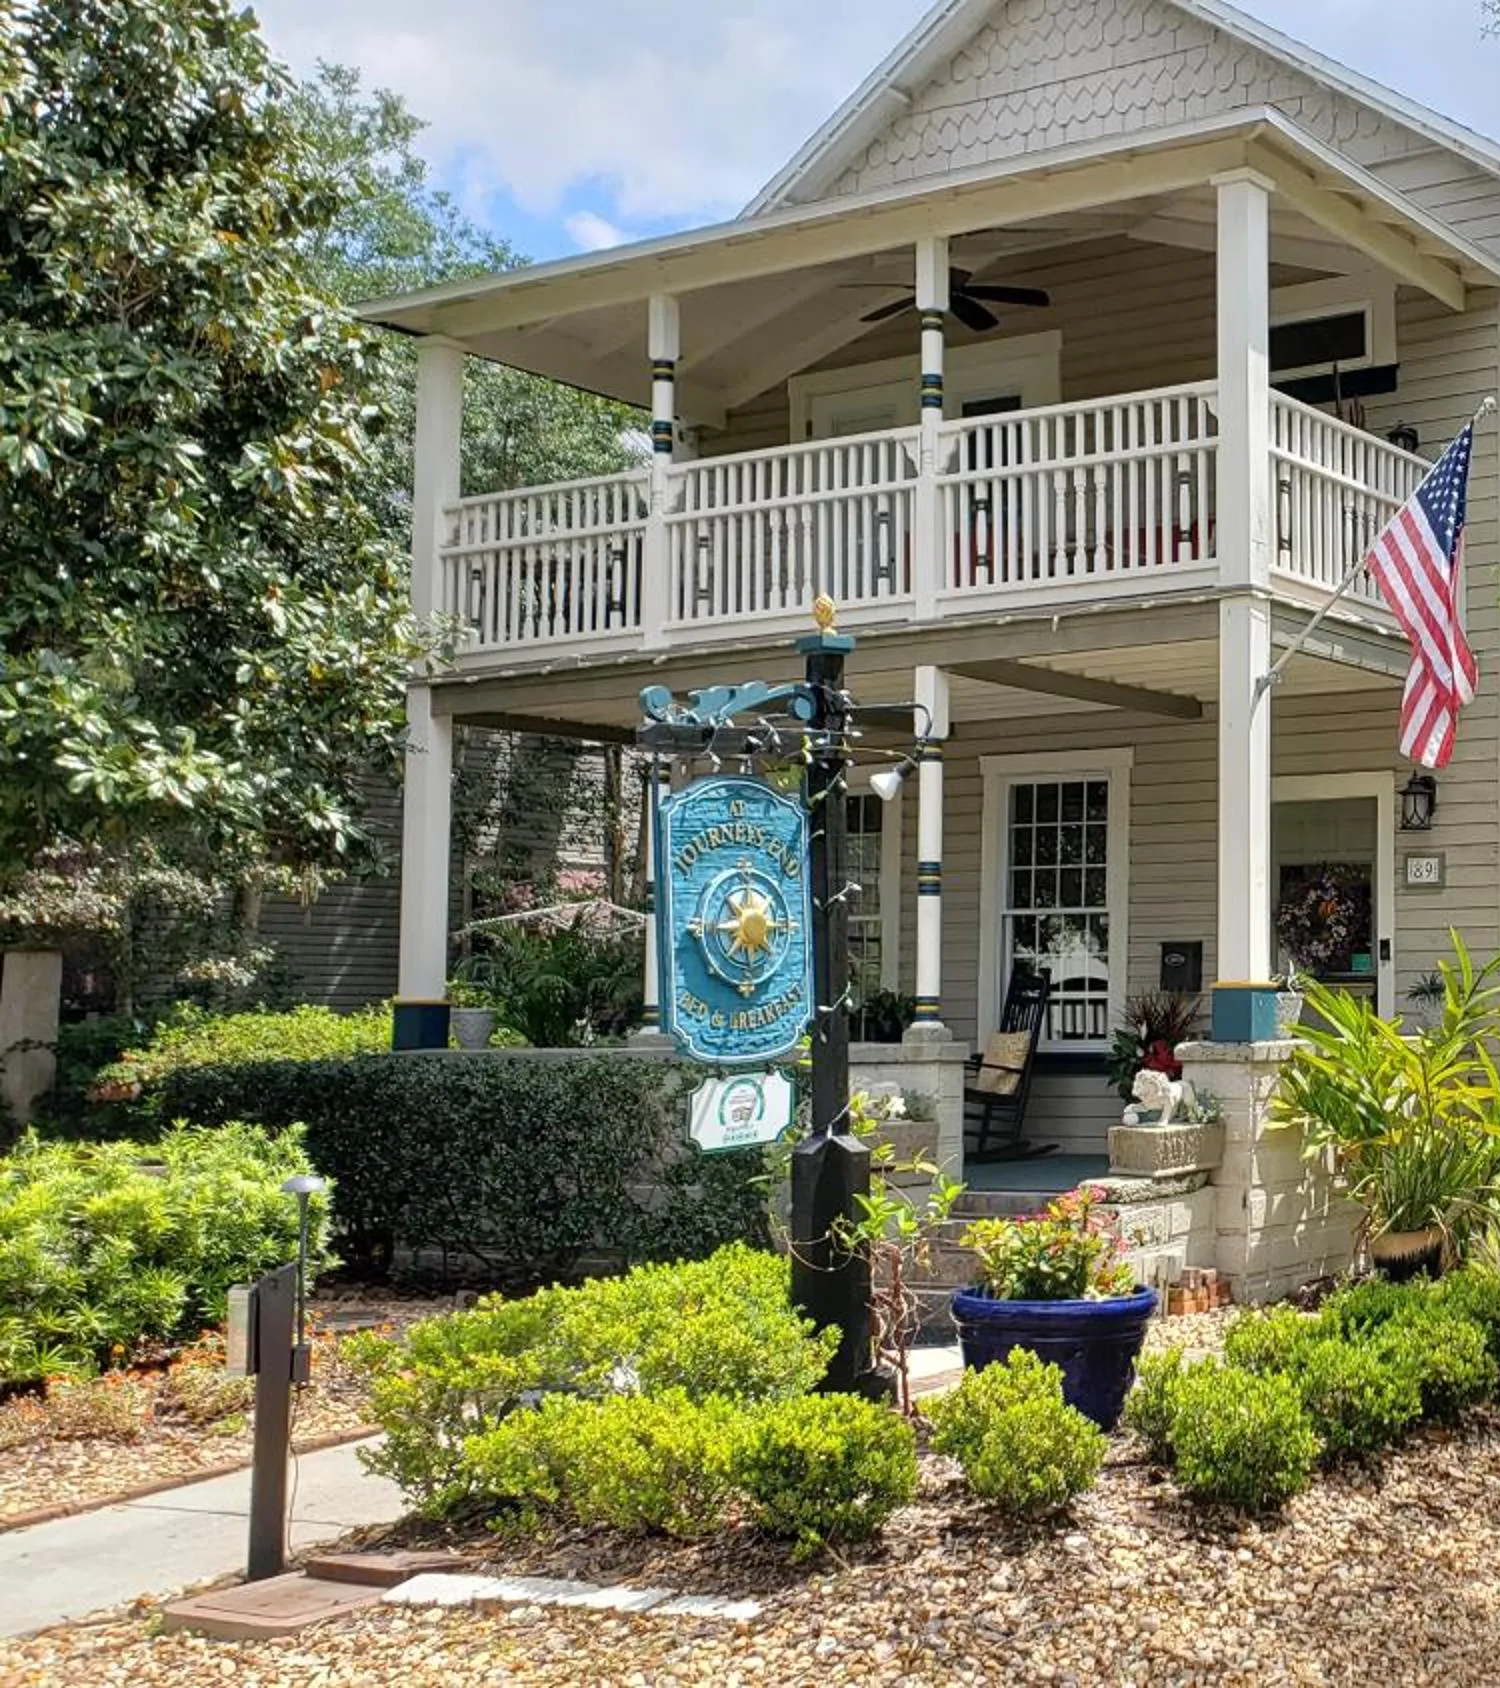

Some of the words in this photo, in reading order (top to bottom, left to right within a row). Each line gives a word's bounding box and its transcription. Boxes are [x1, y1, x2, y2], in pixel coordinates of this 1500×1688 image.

[730, 800, 747, 817] AT
[766, 838, 802, 877] END
[1413, 861, 1433, 879] 89
[678, 991, 709, 1020] BED
[711, 1009, 725, 1027] &
[730, 983, 802, 1029] BREAKFAST
